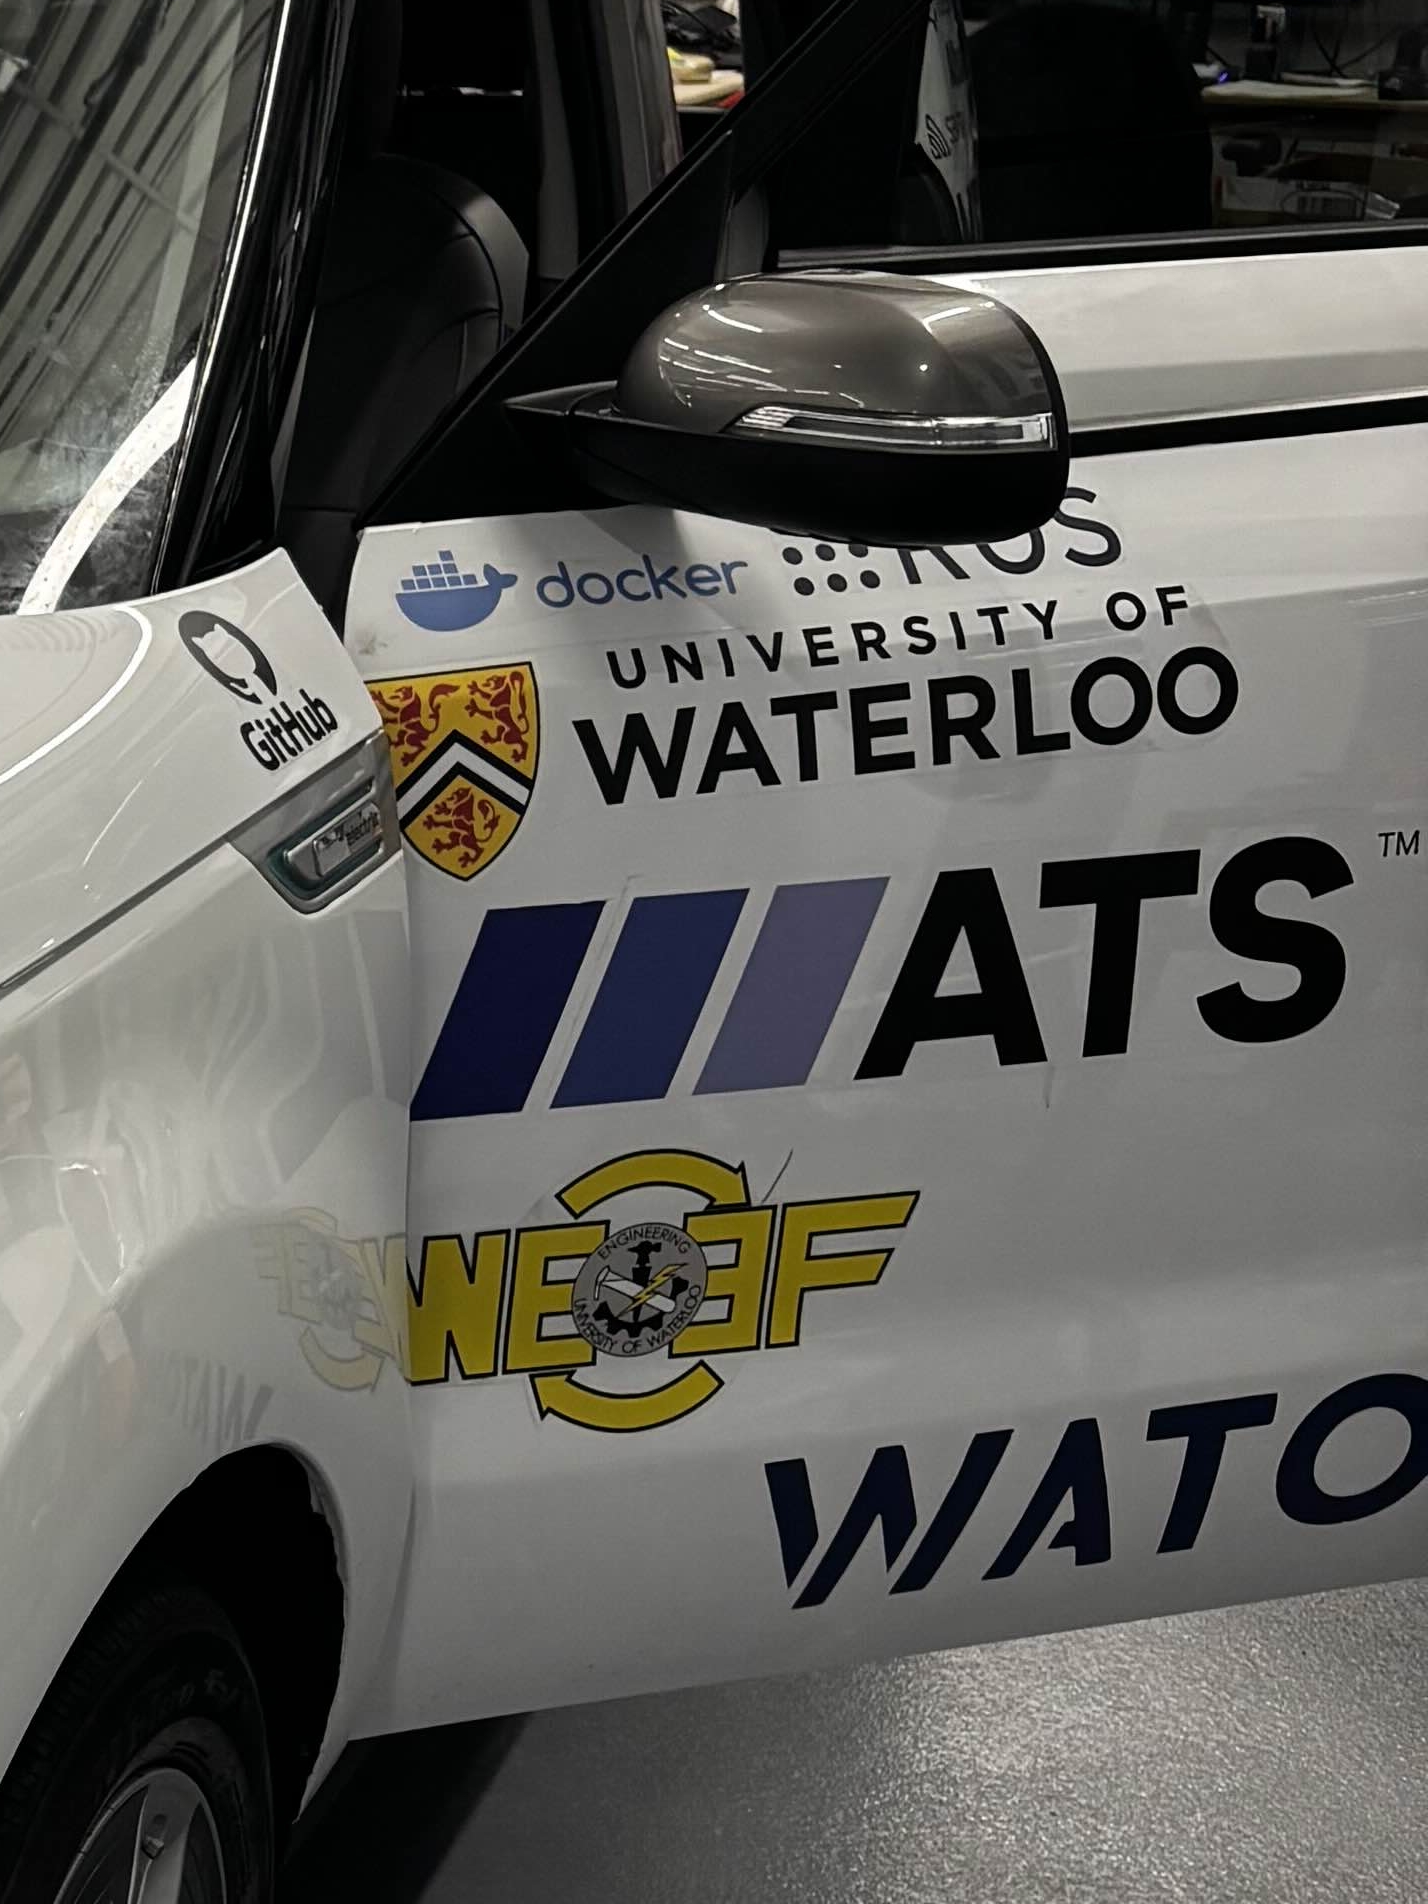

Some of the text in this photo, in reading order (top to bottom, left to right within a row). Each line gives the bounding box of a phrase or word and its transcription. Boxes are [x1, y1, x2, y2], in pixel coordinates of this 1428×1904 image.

[535, 553, 749, 608] docker
[607, 584, 1191, 690] UNIVERSITY OF
[240, 688, 338, 771] GitHub
[572, 645, 1239, 806] WATERLOO
[852, 835, 1355, 1081] ATS
[597, 1226, 692, 1261] ENGINEERING
